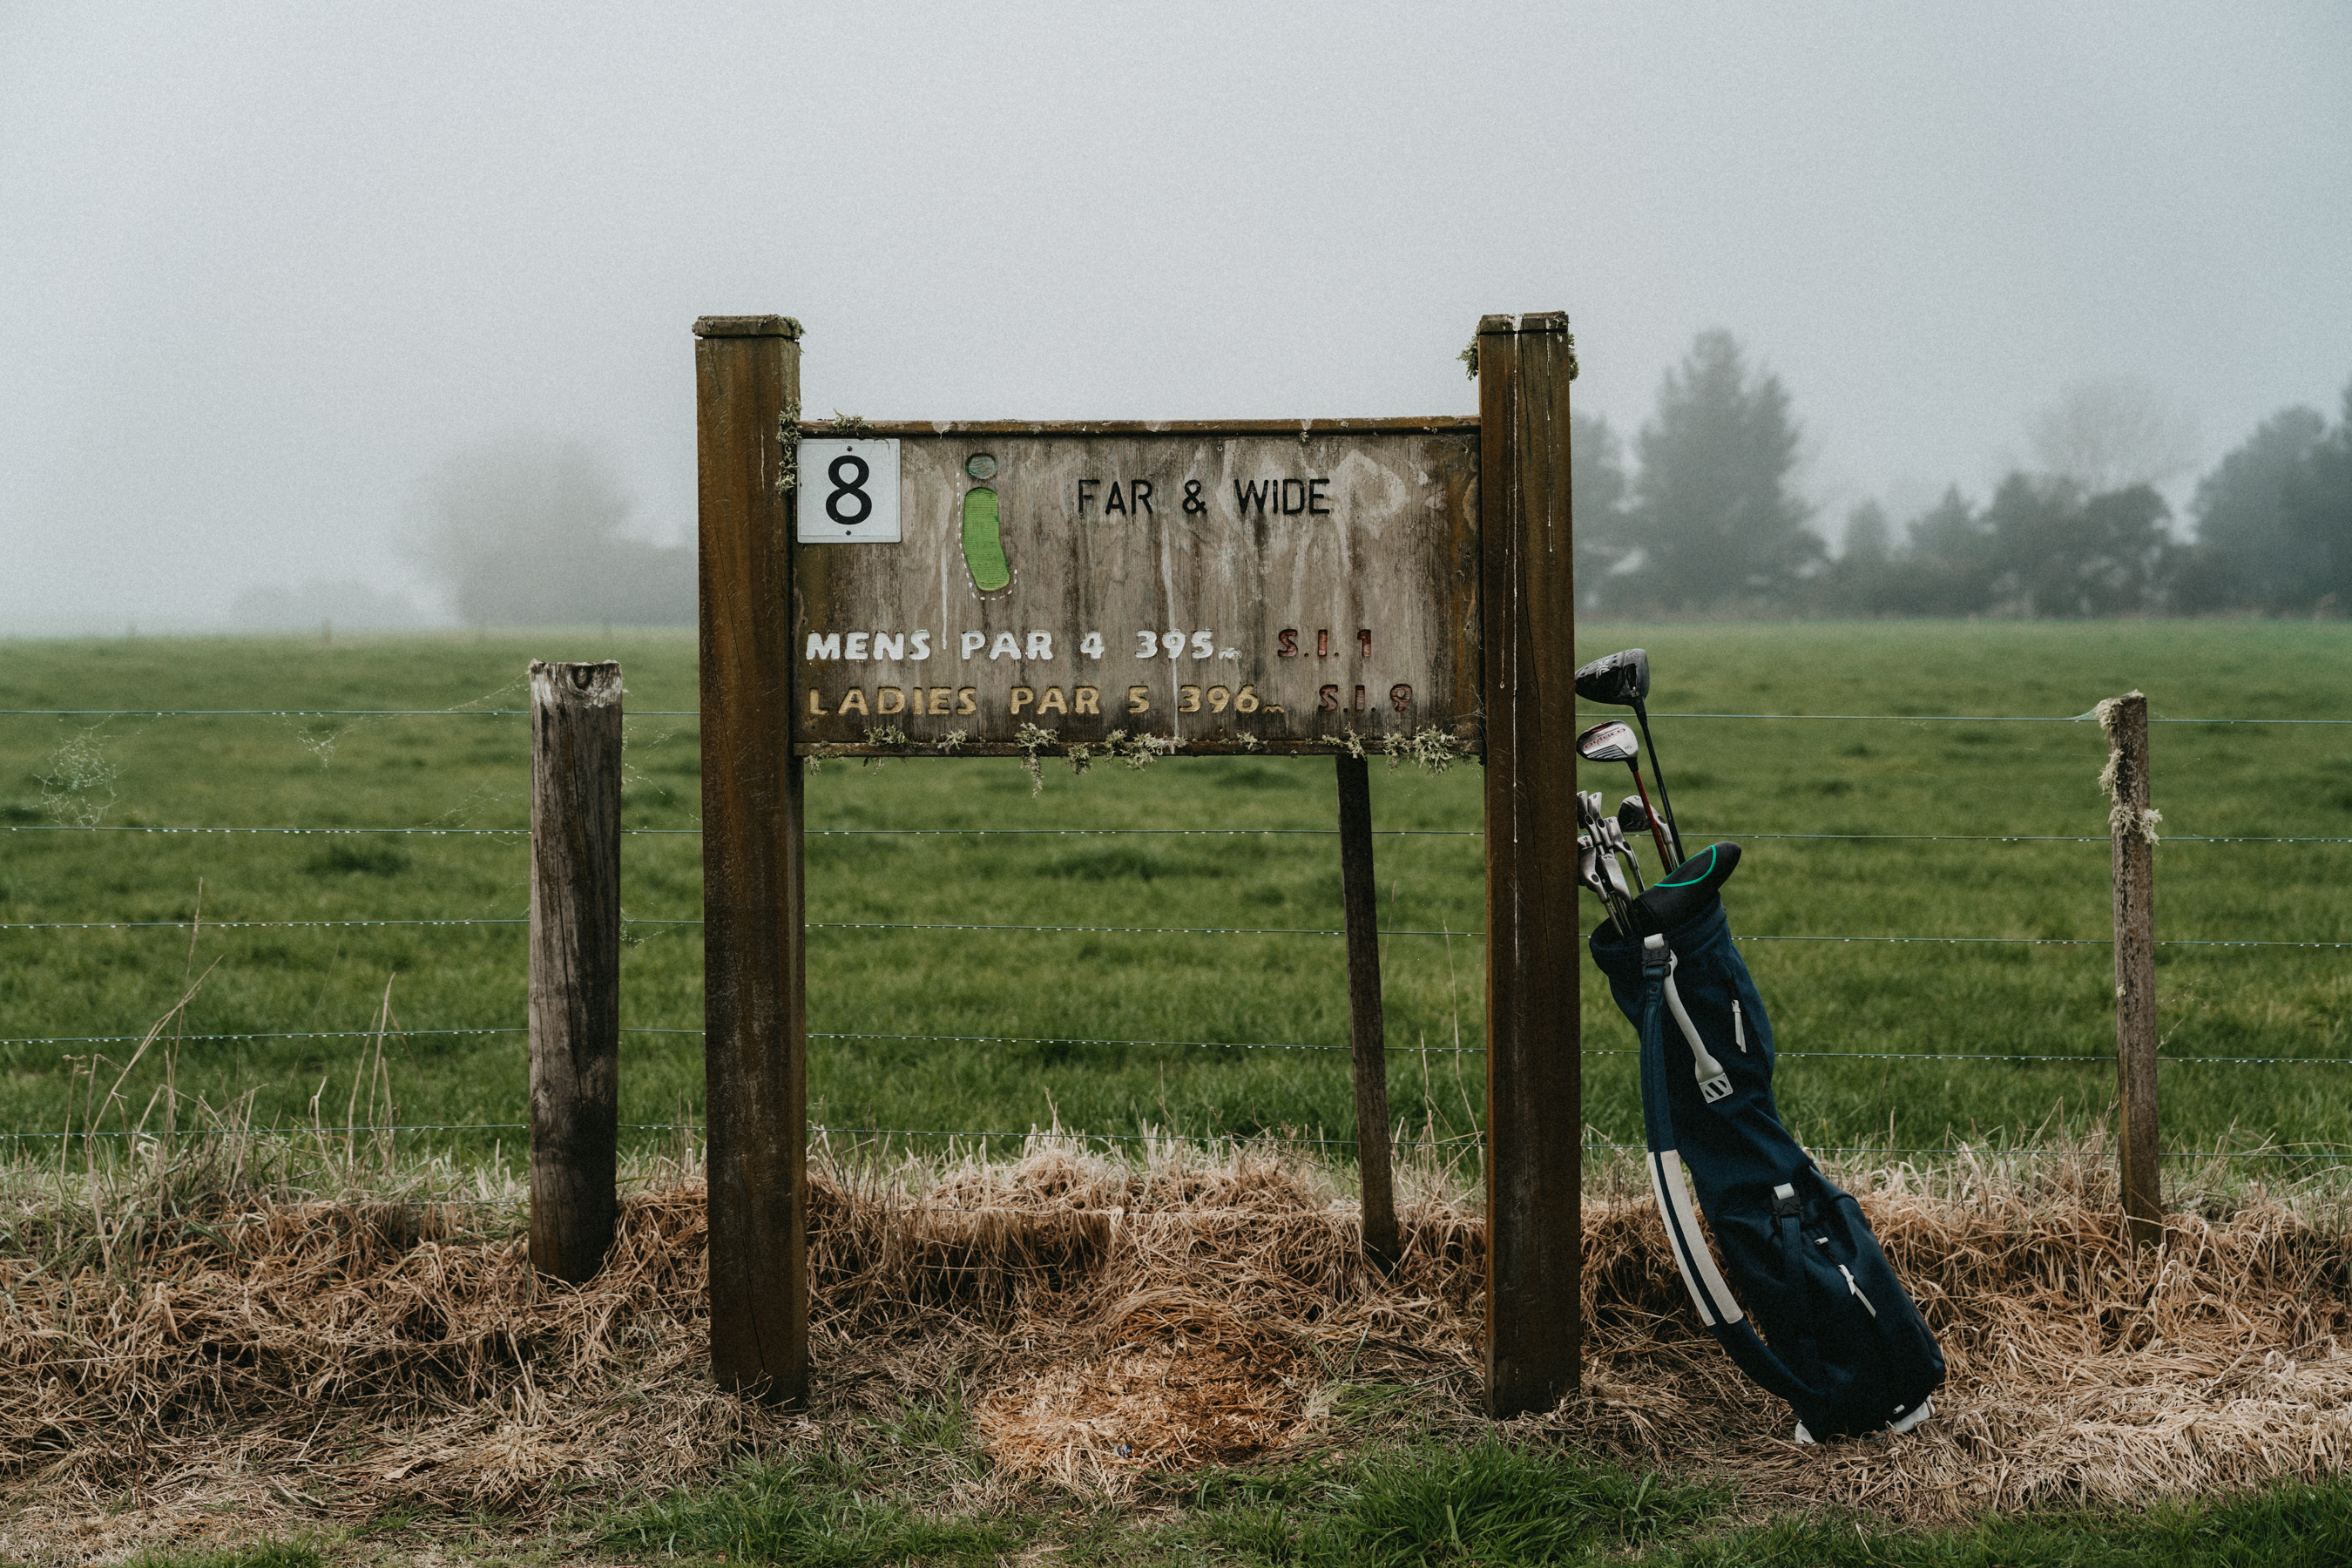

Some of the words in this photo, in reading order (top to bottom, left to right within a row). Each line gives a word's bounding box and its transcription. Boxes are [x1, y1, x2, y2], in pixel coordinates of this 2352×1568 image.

[825, 455, 872, 525] 8
[1078, 479, 1153, 516] FAR
[1181, 479, 1207, 515] &
[1234, 478, 1330, 516] WIDE
[806, 630, 930, 659] MENS
[961, 630, 1053, 659] PAR
[1080, 632, 1105, 659] 4
[1277, 629, 1339, 658] S.I.
[1357, 629, 1372, 658] 1
[808, 686, 977, 716] LADIES
[1010, 686, 1100, 714] PAR
[1128, 686, 1149, 713] 5
[1318, 684, 1375, 713] S.I.
